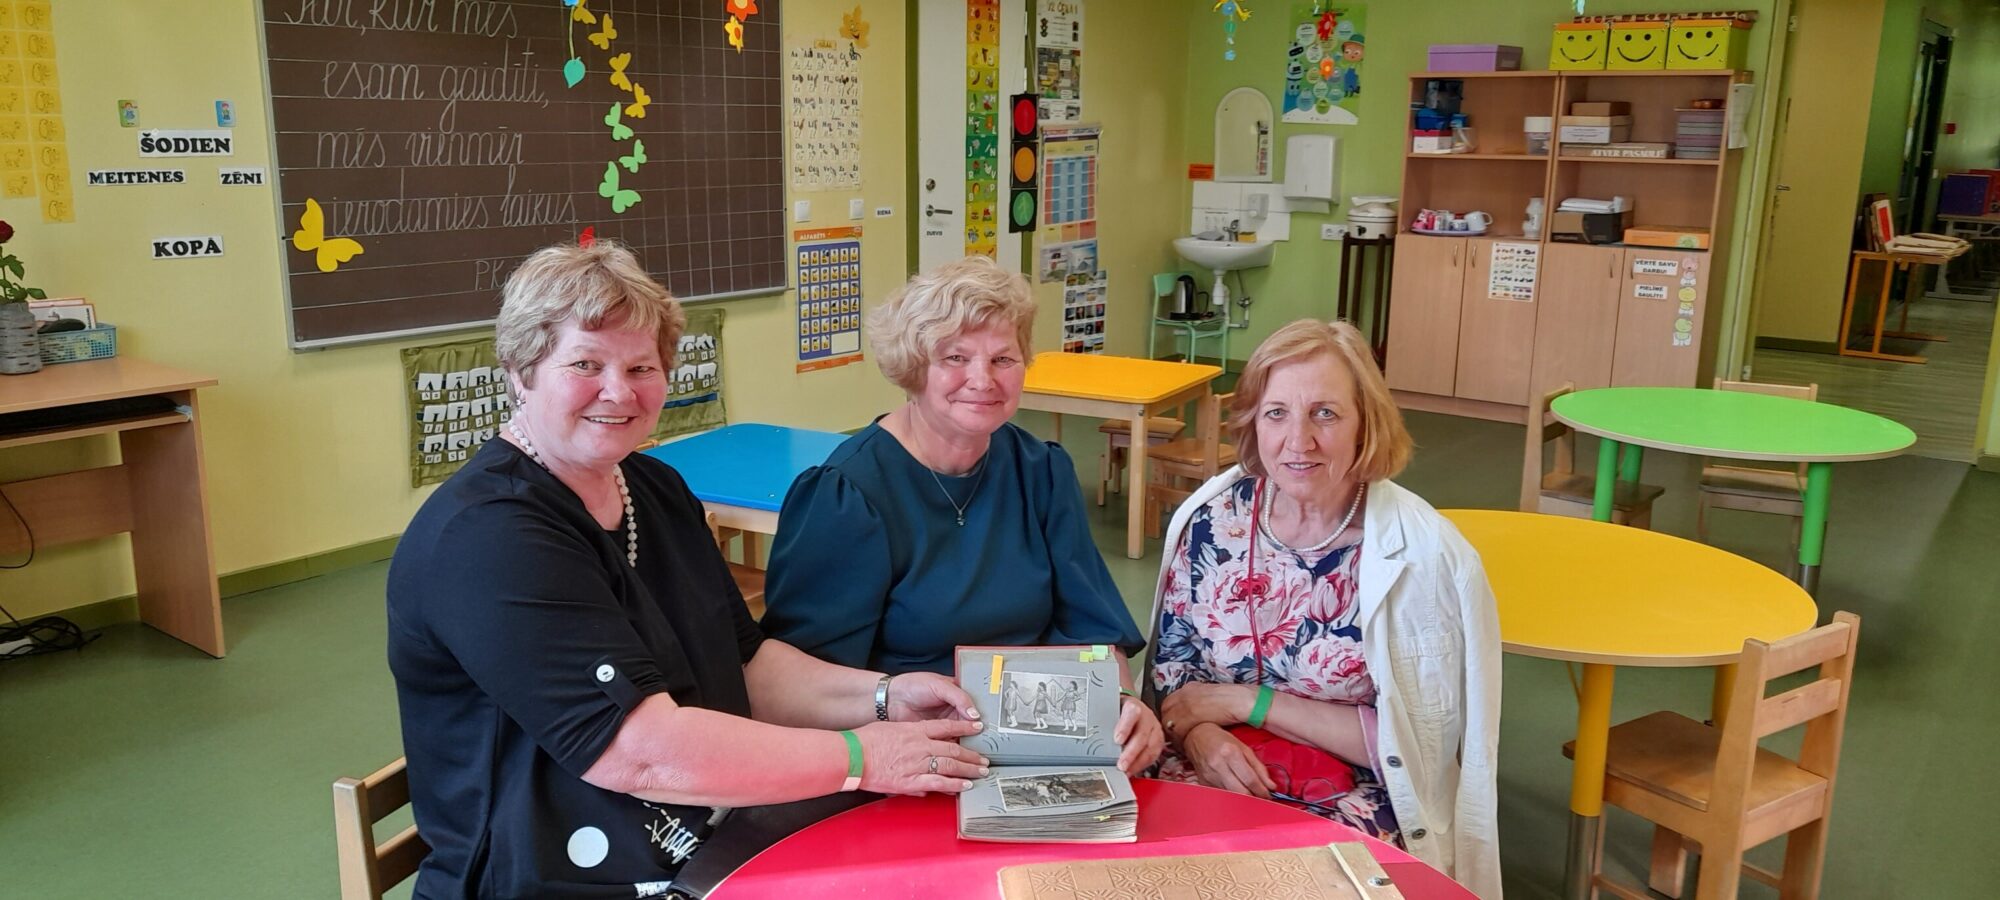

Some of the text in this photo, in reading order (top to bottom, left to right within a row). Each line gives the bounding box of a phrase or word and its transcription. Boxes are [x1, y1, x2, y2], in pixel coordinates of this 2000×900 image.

[322, 60, 424, 100] esam
[140, 133, 231, 153] ŠODIEN
[317, 128, 386, 169] mēs
[89, 170, 184, 184] MEITENES
[220, 172, 262, 185] ZĒNI
[153, 237, 222, 258] KOPĀ
